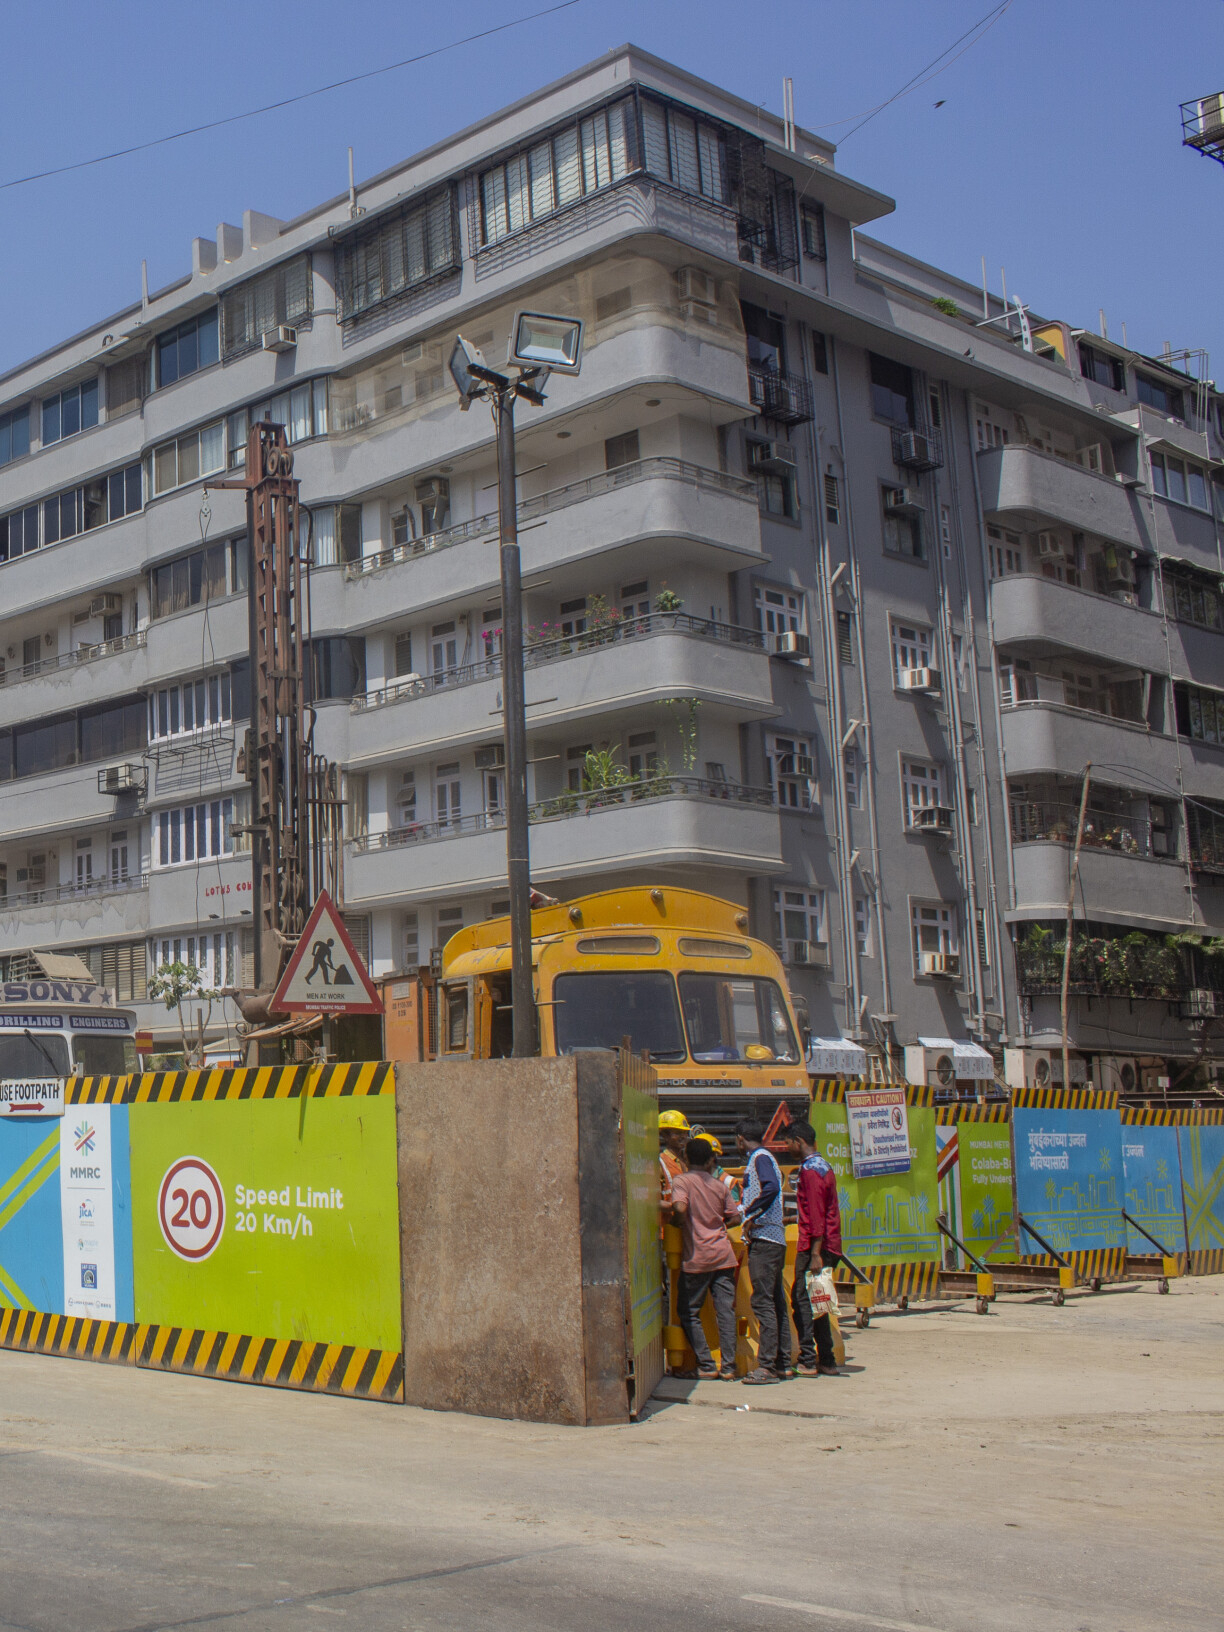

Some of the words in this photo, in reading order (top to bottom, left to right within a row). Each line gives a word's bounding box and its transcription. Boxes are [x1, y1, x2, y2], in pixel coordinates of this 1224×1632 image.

[206, 884, 230, 897] LOTUS
[4, 981, 96, 1003] SONY
[72, 1017, 126, 1029] ENGINEERS
[0, 1084, 13, 1101] USE
[14, 1083, 59, 1100] FOOTPATH
[970, 1141, 992, 1149] MUMBAI
[994, 1141, 1010, 1149] METR
[70, 1167, 101, 1179] MMRC
[972, 1174, 989, 1185] Fully
[235, 1184, 290, 1209] Speed
[296, 1186, 344, 1209] Limit
[171, 1188, 211, 1229] 20
[235, 1211, 257, 1232] 20
[263, 1213, 313, 1240] Km/h
